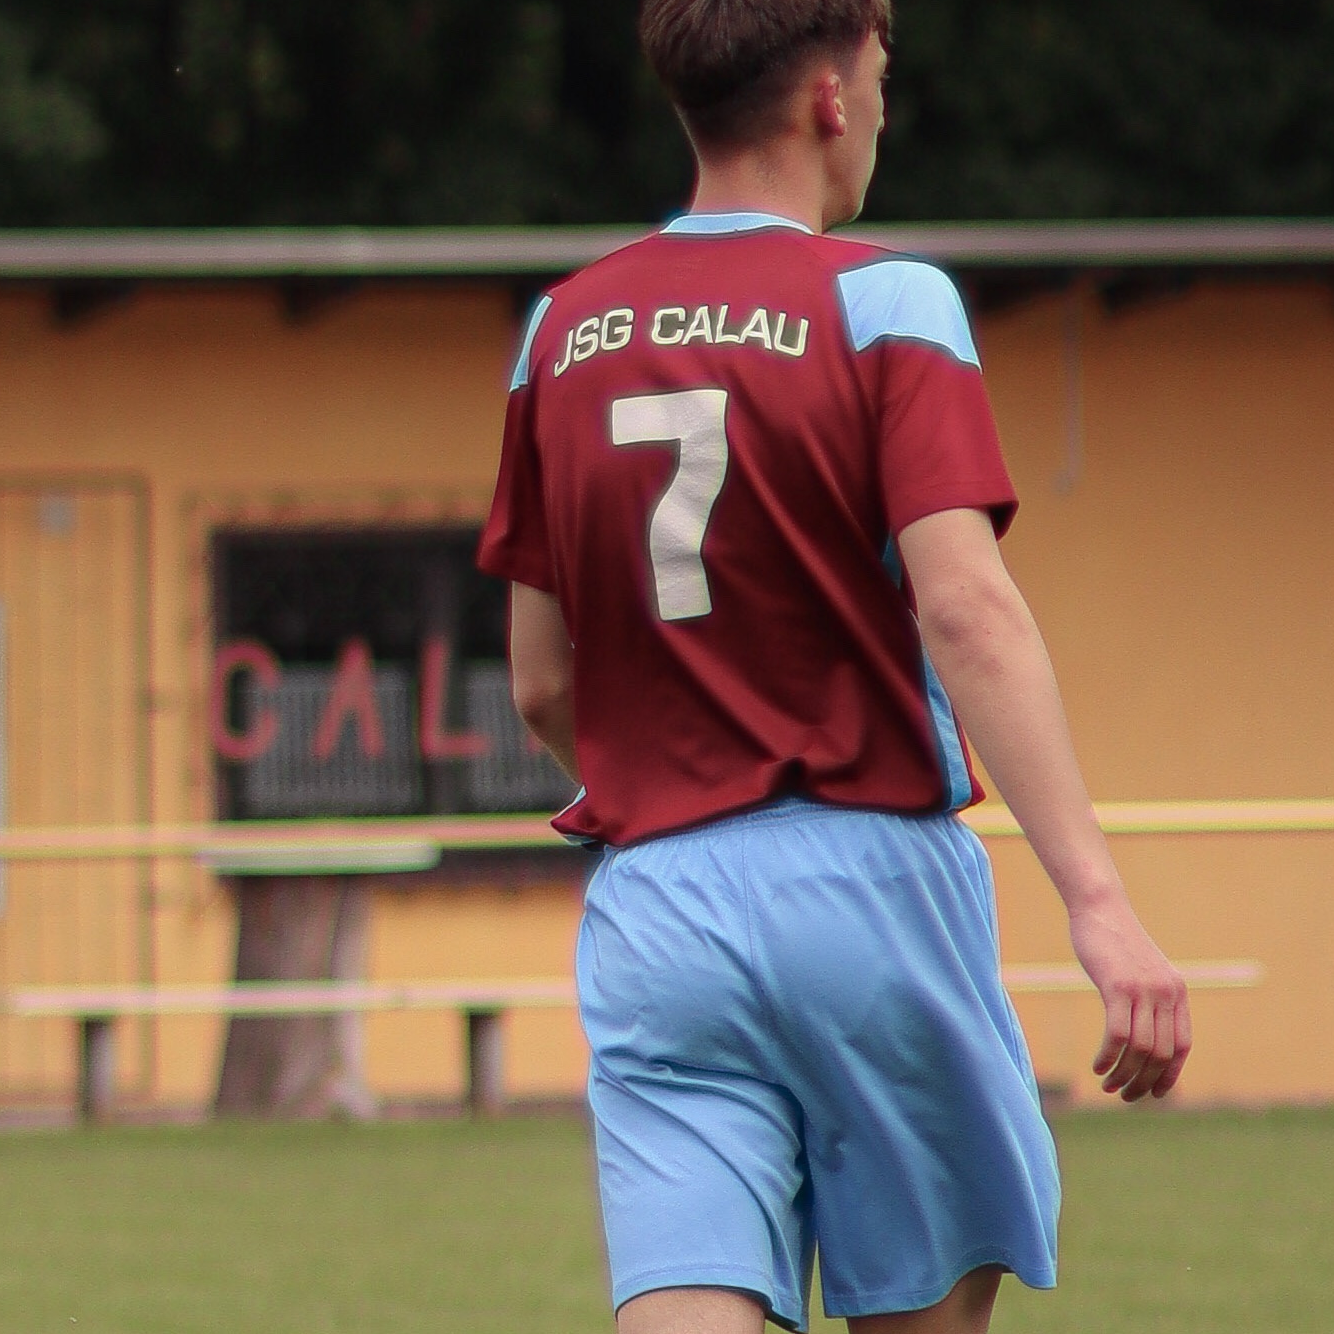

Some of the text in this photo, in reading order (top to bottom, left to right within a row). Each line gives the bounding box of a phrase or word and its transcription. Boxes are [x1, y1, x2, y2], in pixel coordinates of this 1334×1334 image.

[554, 304, 809, 378] JSG CALAU
[612, 388, 729, 621] 7
[210, 637, 540, 759] CAL
